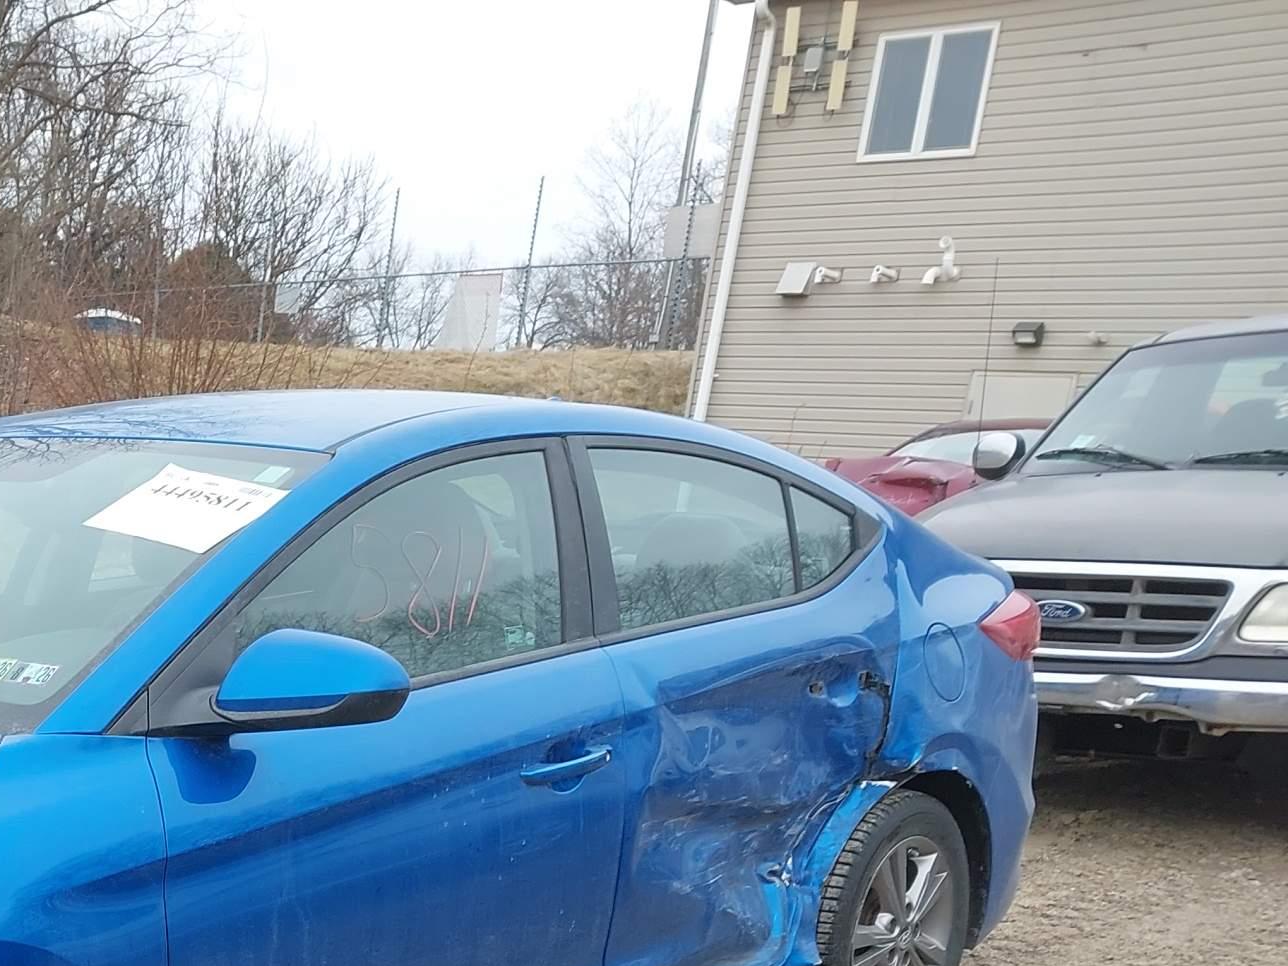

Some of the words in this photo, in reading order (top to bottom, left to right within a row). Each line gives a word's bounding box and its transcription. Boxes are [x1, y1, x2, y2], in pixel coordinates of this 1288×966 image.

[151, 484, 255, 512] 44495811
[351, 524, 488, 638] 5811
[1041, 604, 1073, 618] Ford
